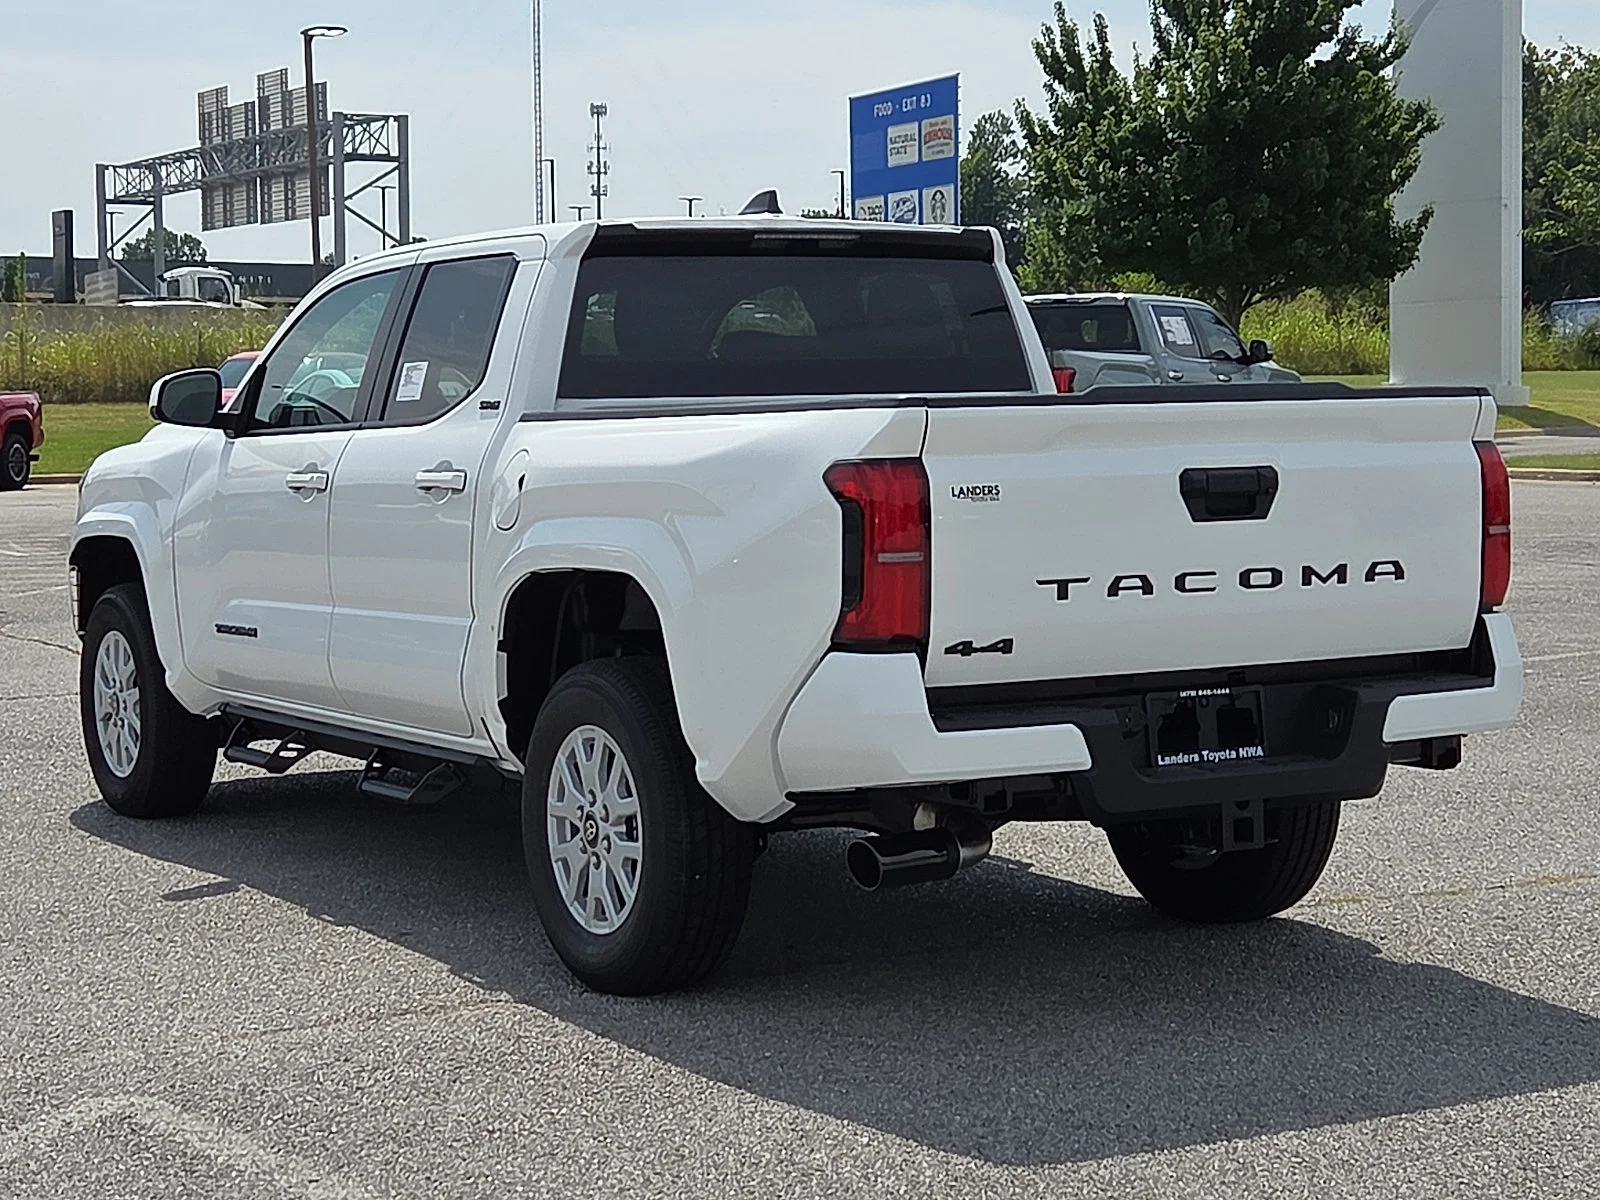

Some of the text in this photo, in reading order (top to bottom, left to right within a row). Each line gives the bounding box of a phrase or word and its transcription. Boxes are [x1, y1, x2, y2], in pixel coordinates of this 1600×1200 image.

[873, 101, 893, 118] FOOD
[902, 96, 917, 112] EXIT
[889, 132, 917, 145] NATURAL
[889, 145, 908, 157] STATE
[951, 484, 1001, 499] LANDERS
[1036, 560, 1405, 601] TACOMA
[1157, 745, 1264, 766] Landers Toyota NWA
